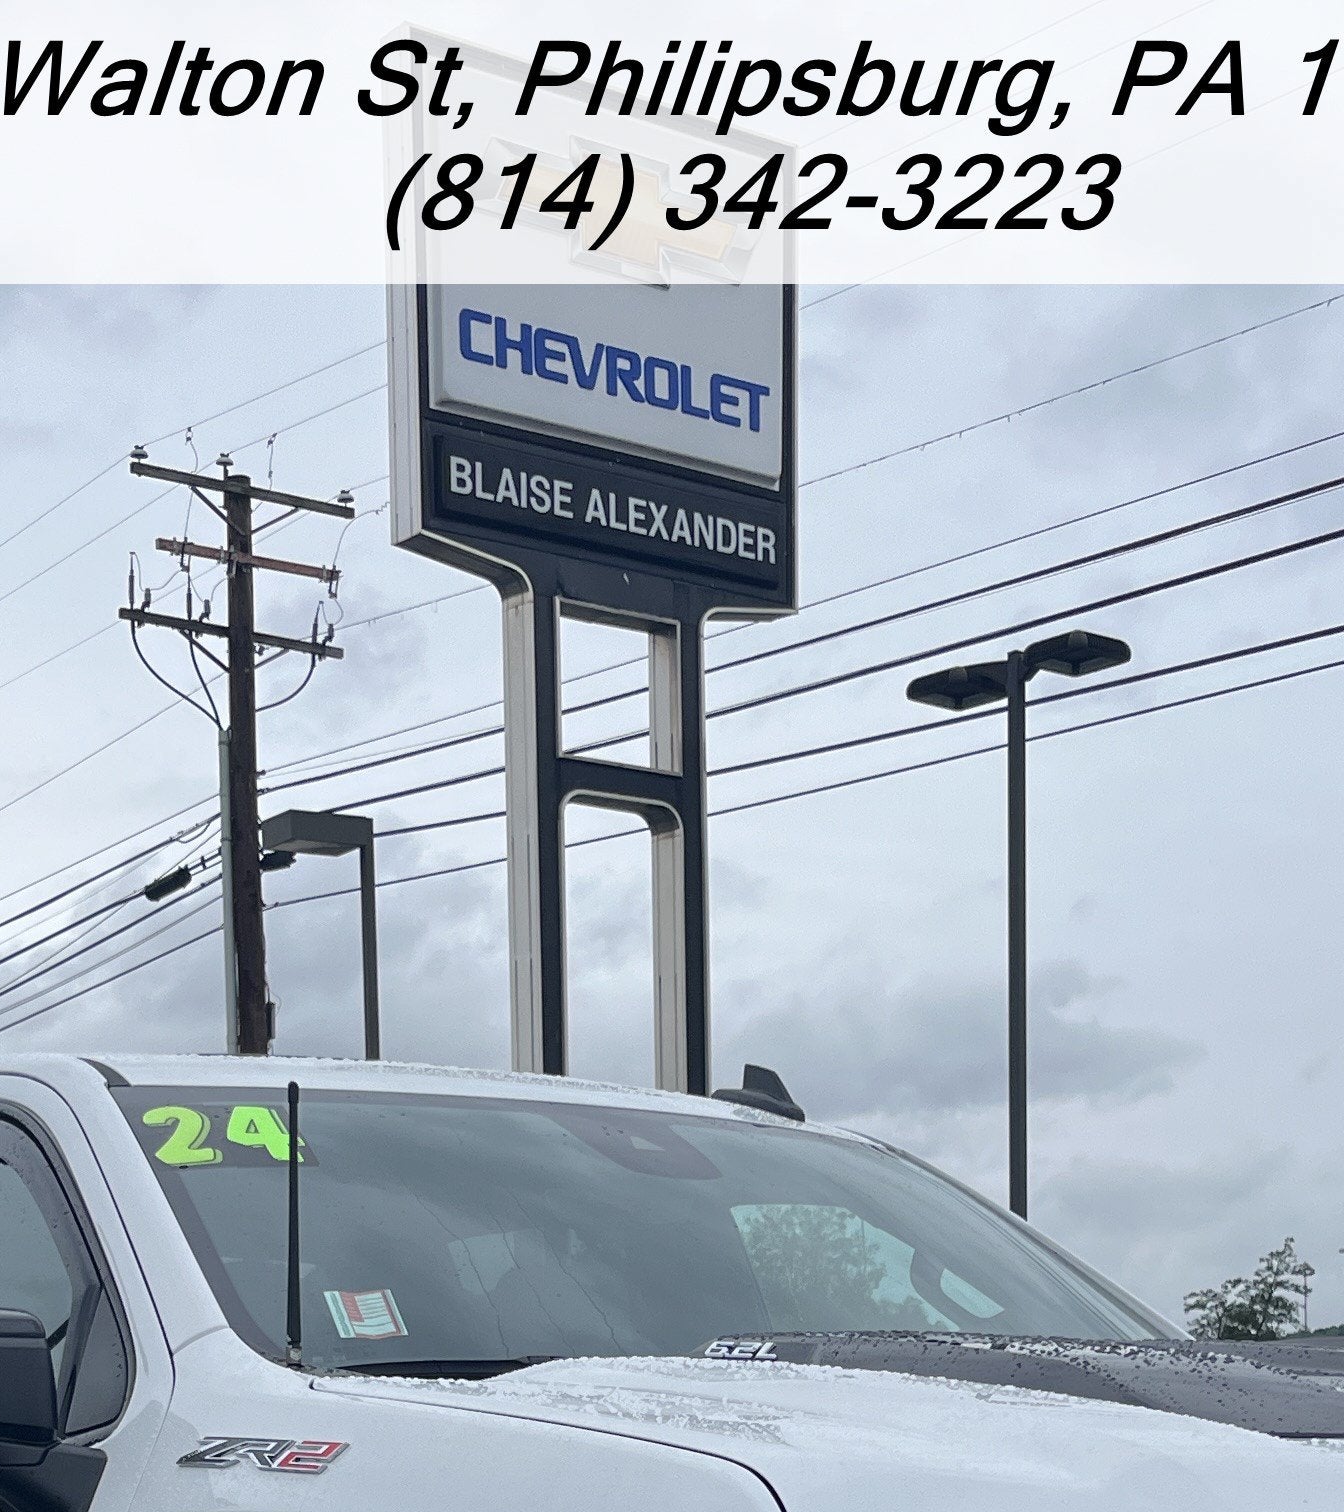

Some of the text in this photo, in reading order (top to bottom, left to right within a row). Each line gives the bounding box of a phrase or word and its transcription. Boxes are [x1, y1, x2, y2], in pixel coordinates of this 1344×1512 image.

[458, 307, 771, 433] CHEVROLET
[449, 455, 777, 565] BLAISE ALEXANDER
[142, 1105, 305, 1167] 24
[176, 1437, 350, 1475] ZR2
